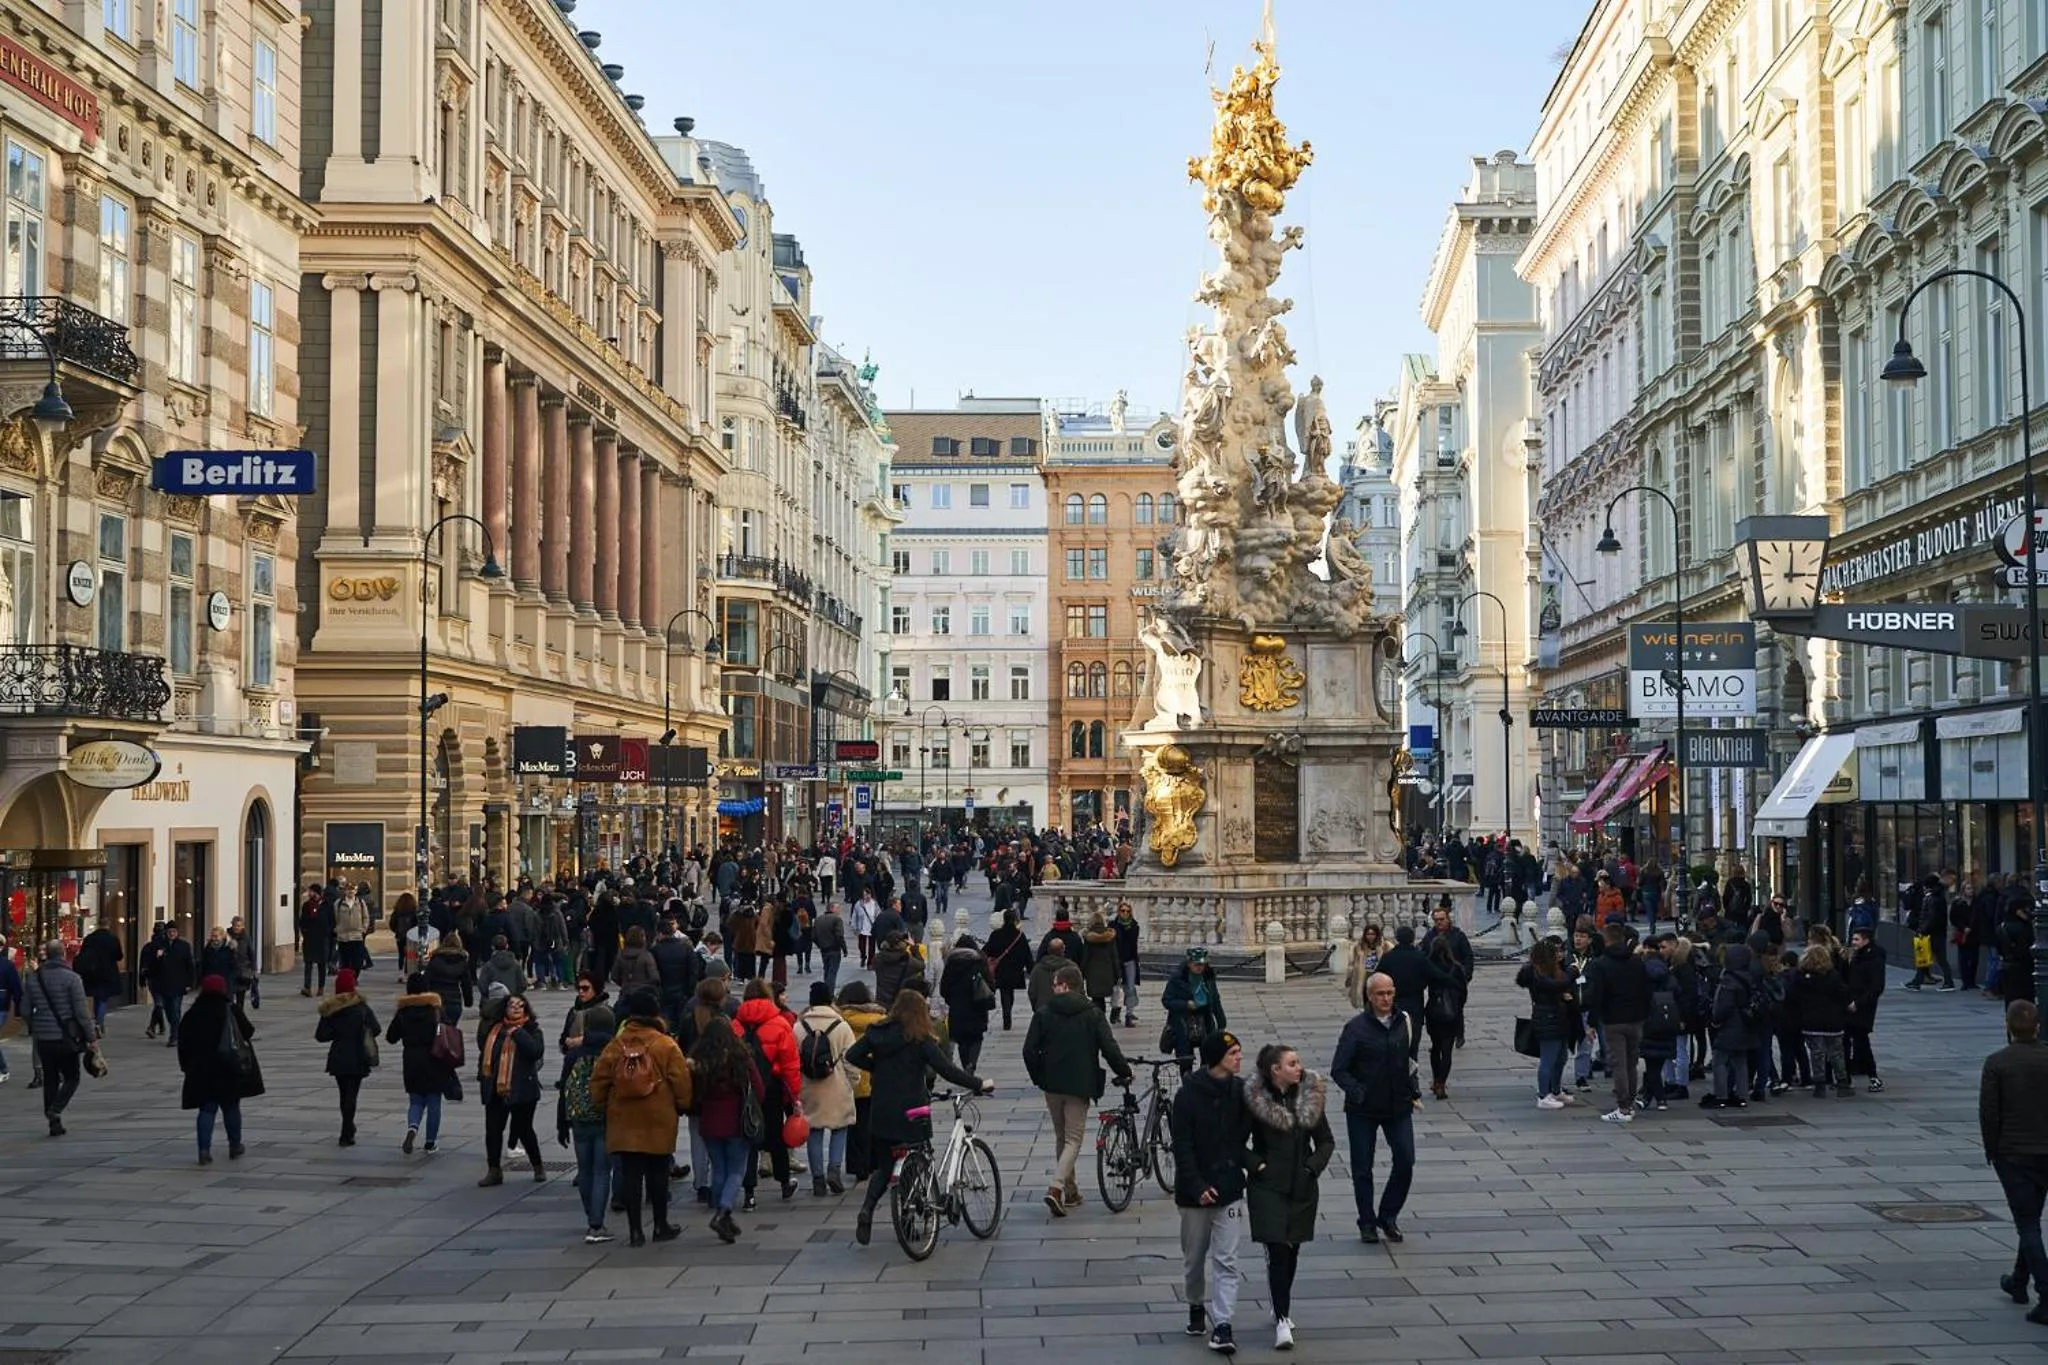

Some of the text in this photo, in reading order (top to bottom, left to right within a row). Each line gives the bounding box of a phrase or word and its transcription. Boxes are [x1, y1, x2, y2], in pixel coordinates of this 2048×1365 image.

[65, 85, 93, 121] HOF
[182, 455, 296, 485] Berlitz
[1917, 517, 1967, 565] RUDOLF
[1975, 496, 2036, 543] HÜBNE
[1847, 612, 1955, 630] HÜBNER
[1642, 632, 1744, 646] wienerin
[1536, 711, 1622, 722] AVANTGARDE
[519, 761, 560, 772] MaxMara
[131, 780, 190, 801] HELDWEIN
[335, 852, 375, 862] MaxMara
